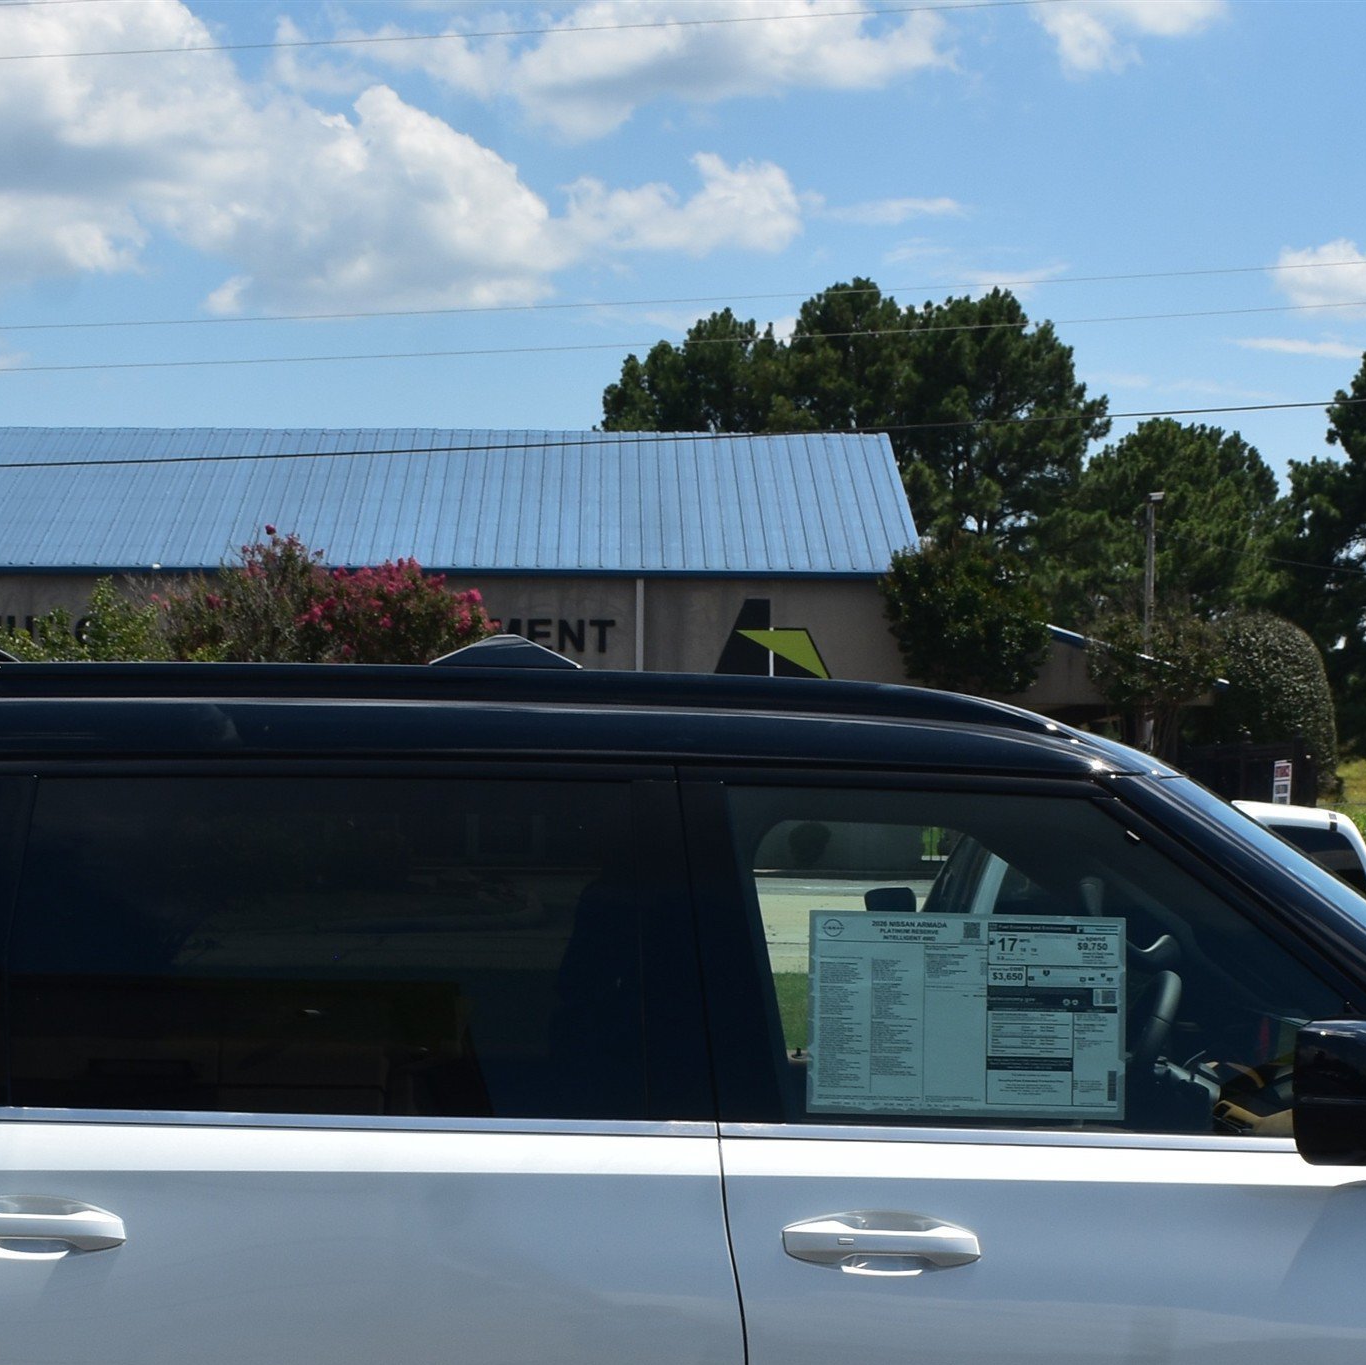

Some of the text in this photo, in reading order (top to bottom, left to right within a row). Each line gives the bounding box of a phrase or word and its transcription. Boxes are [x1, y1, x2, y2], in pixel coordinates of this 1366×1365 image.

[889, 920, 915, 928] NISSAN
[917, 921, 947, 929] ARMADA
[998, 937, 1018, 952] 17
[992, 971, 1023, 981] $3,650
